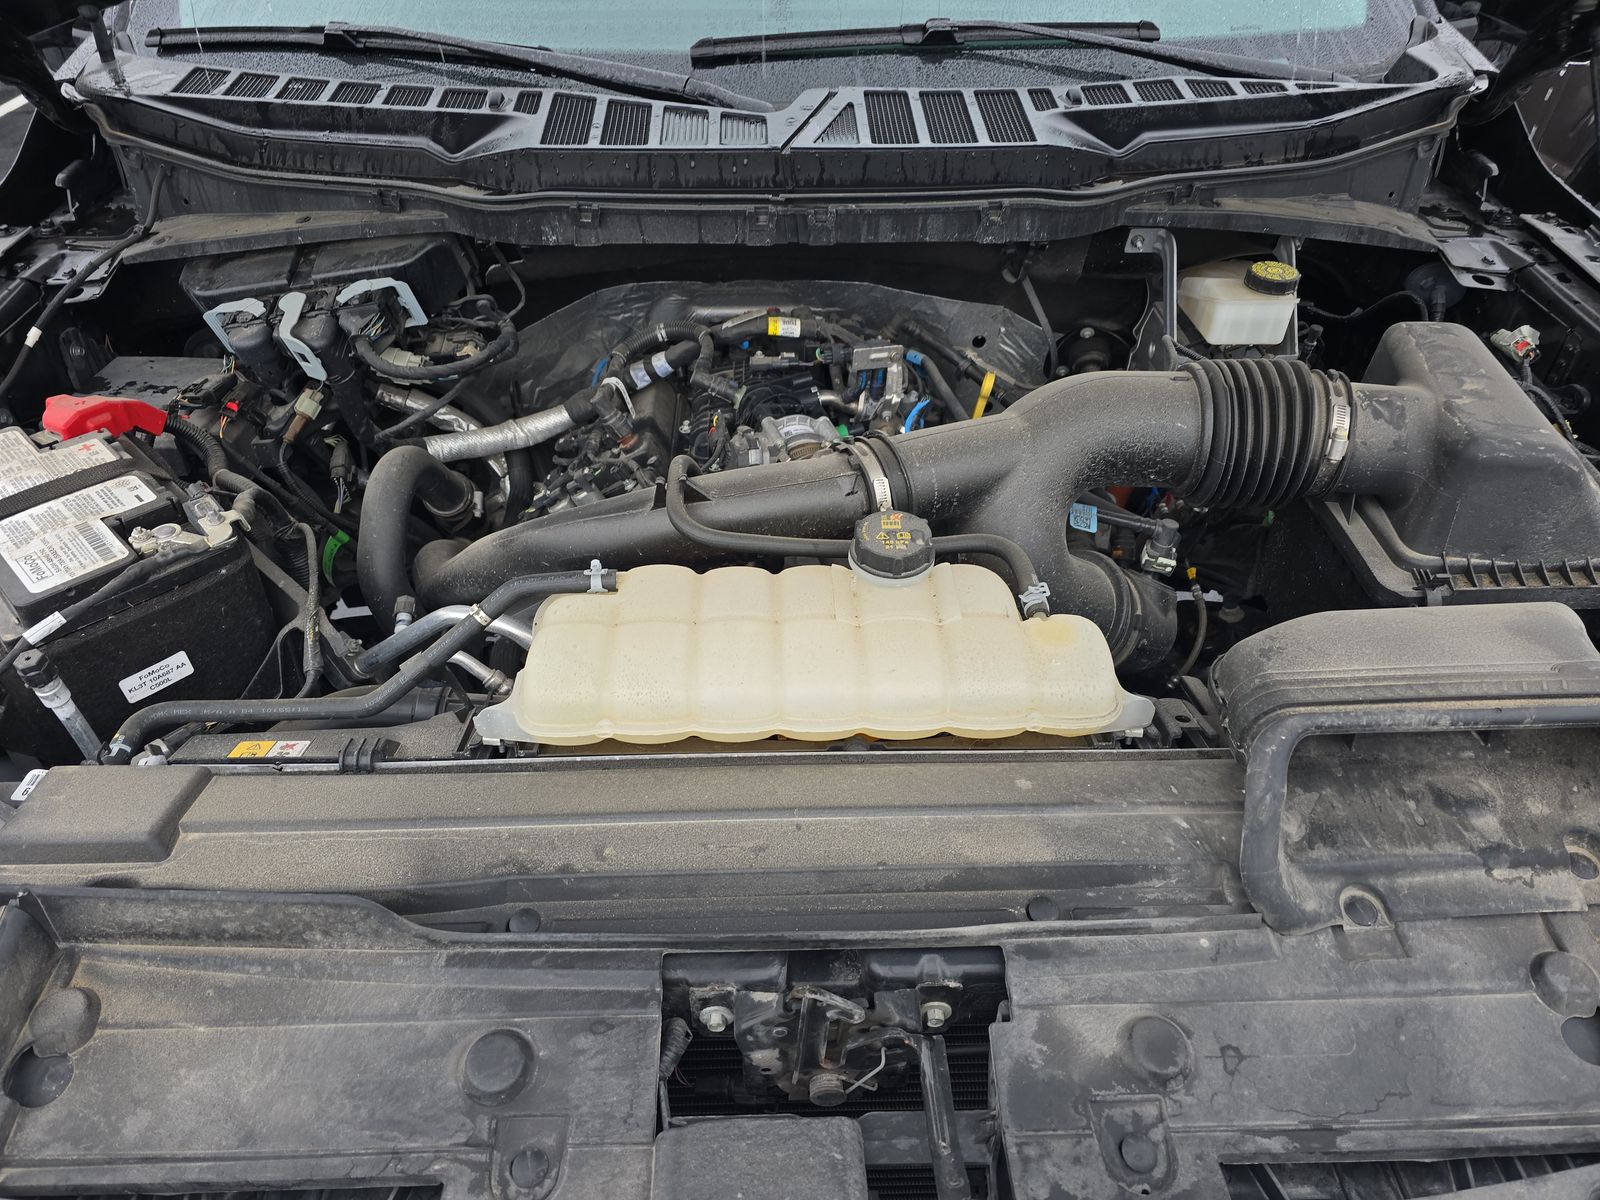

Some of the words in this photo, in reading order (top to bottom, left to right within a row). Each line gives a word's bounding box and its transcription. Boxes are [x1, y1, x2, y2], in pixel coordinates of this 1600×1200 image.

[24, 554, 48, 581] FoMoCo
[127, 681, 147, 694] KL3T
[176, 662, 186, 671] AA
[139, 663, 170, 681] FoMoCo
[149, 676, 173, 691] C500L
